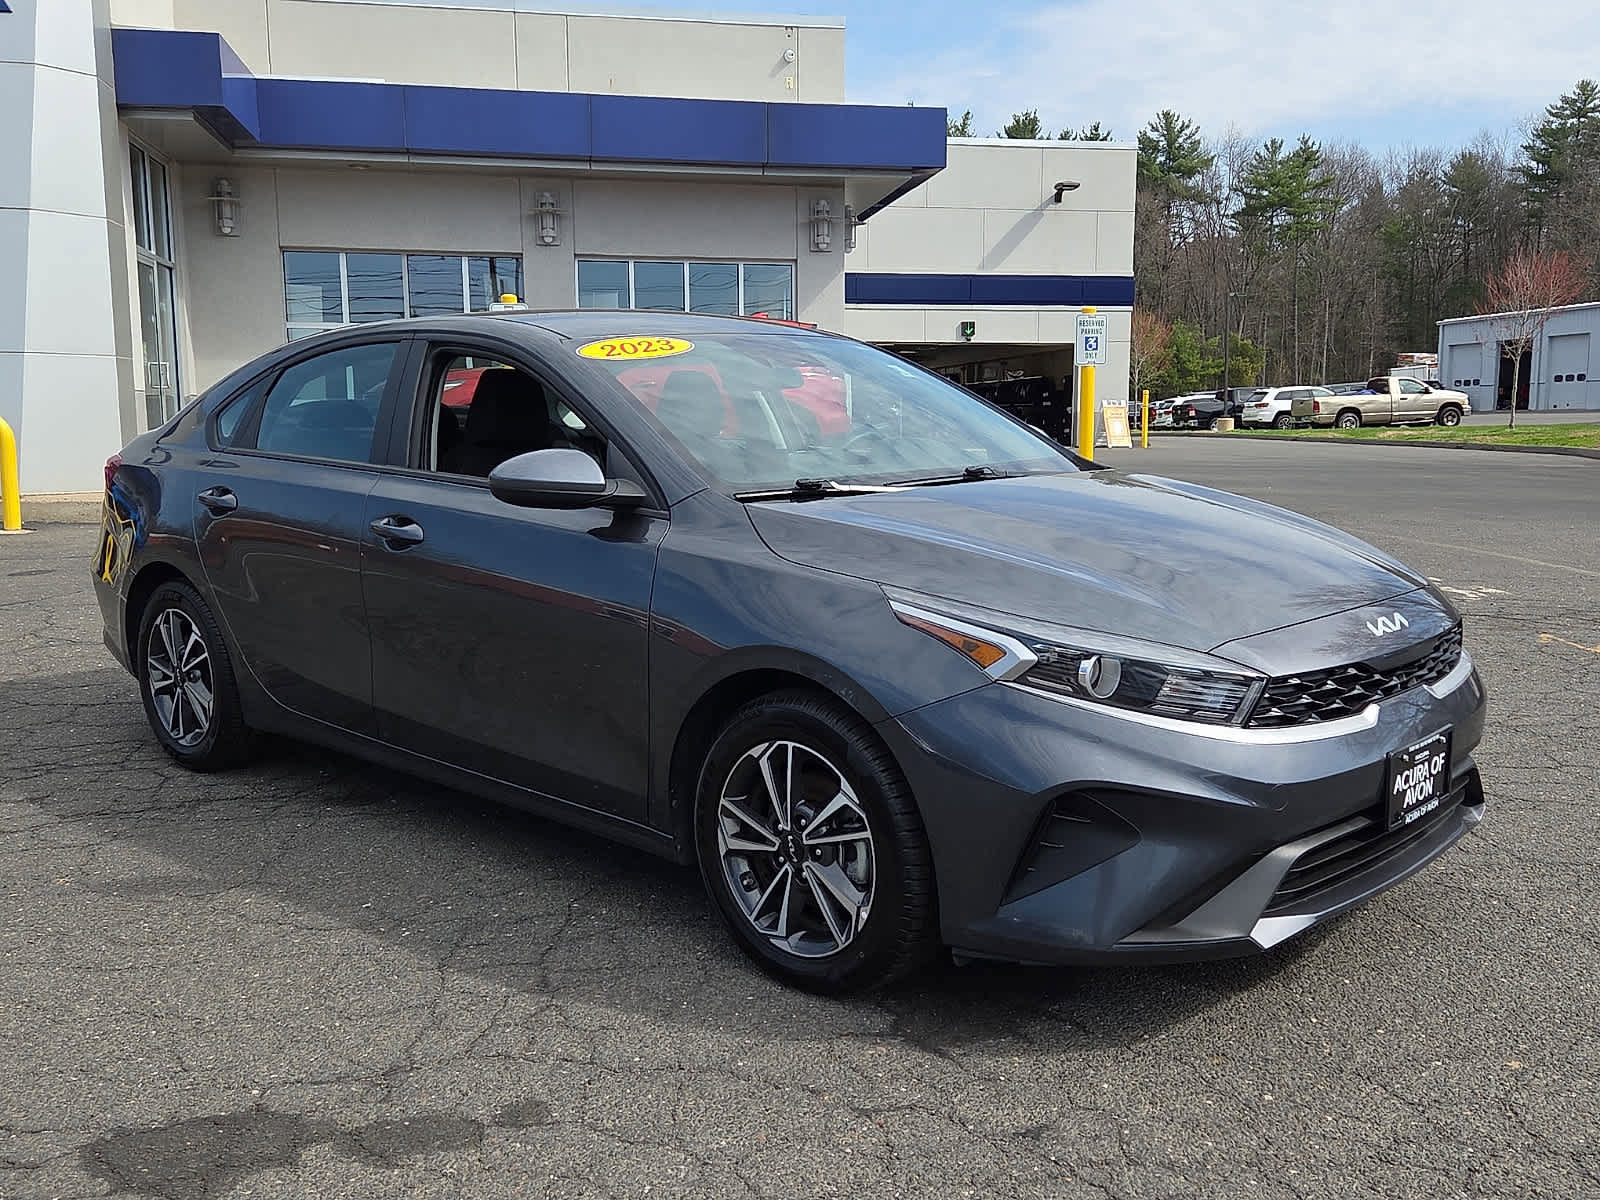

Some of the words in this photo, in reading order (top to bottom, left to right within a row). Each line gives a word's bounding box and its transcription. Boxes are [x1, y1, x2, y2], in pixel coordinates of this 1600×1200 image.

[1079, 319, 1105, 327] RESERVED
[600, 339, 675, 357] 2023
[1366, 611, 1409, 637] KIA
[1393, 761, 1430, 795] ACURA
[1431, 752, 1446, 775] OF
[1403, 776, 1434, 809] AVON
